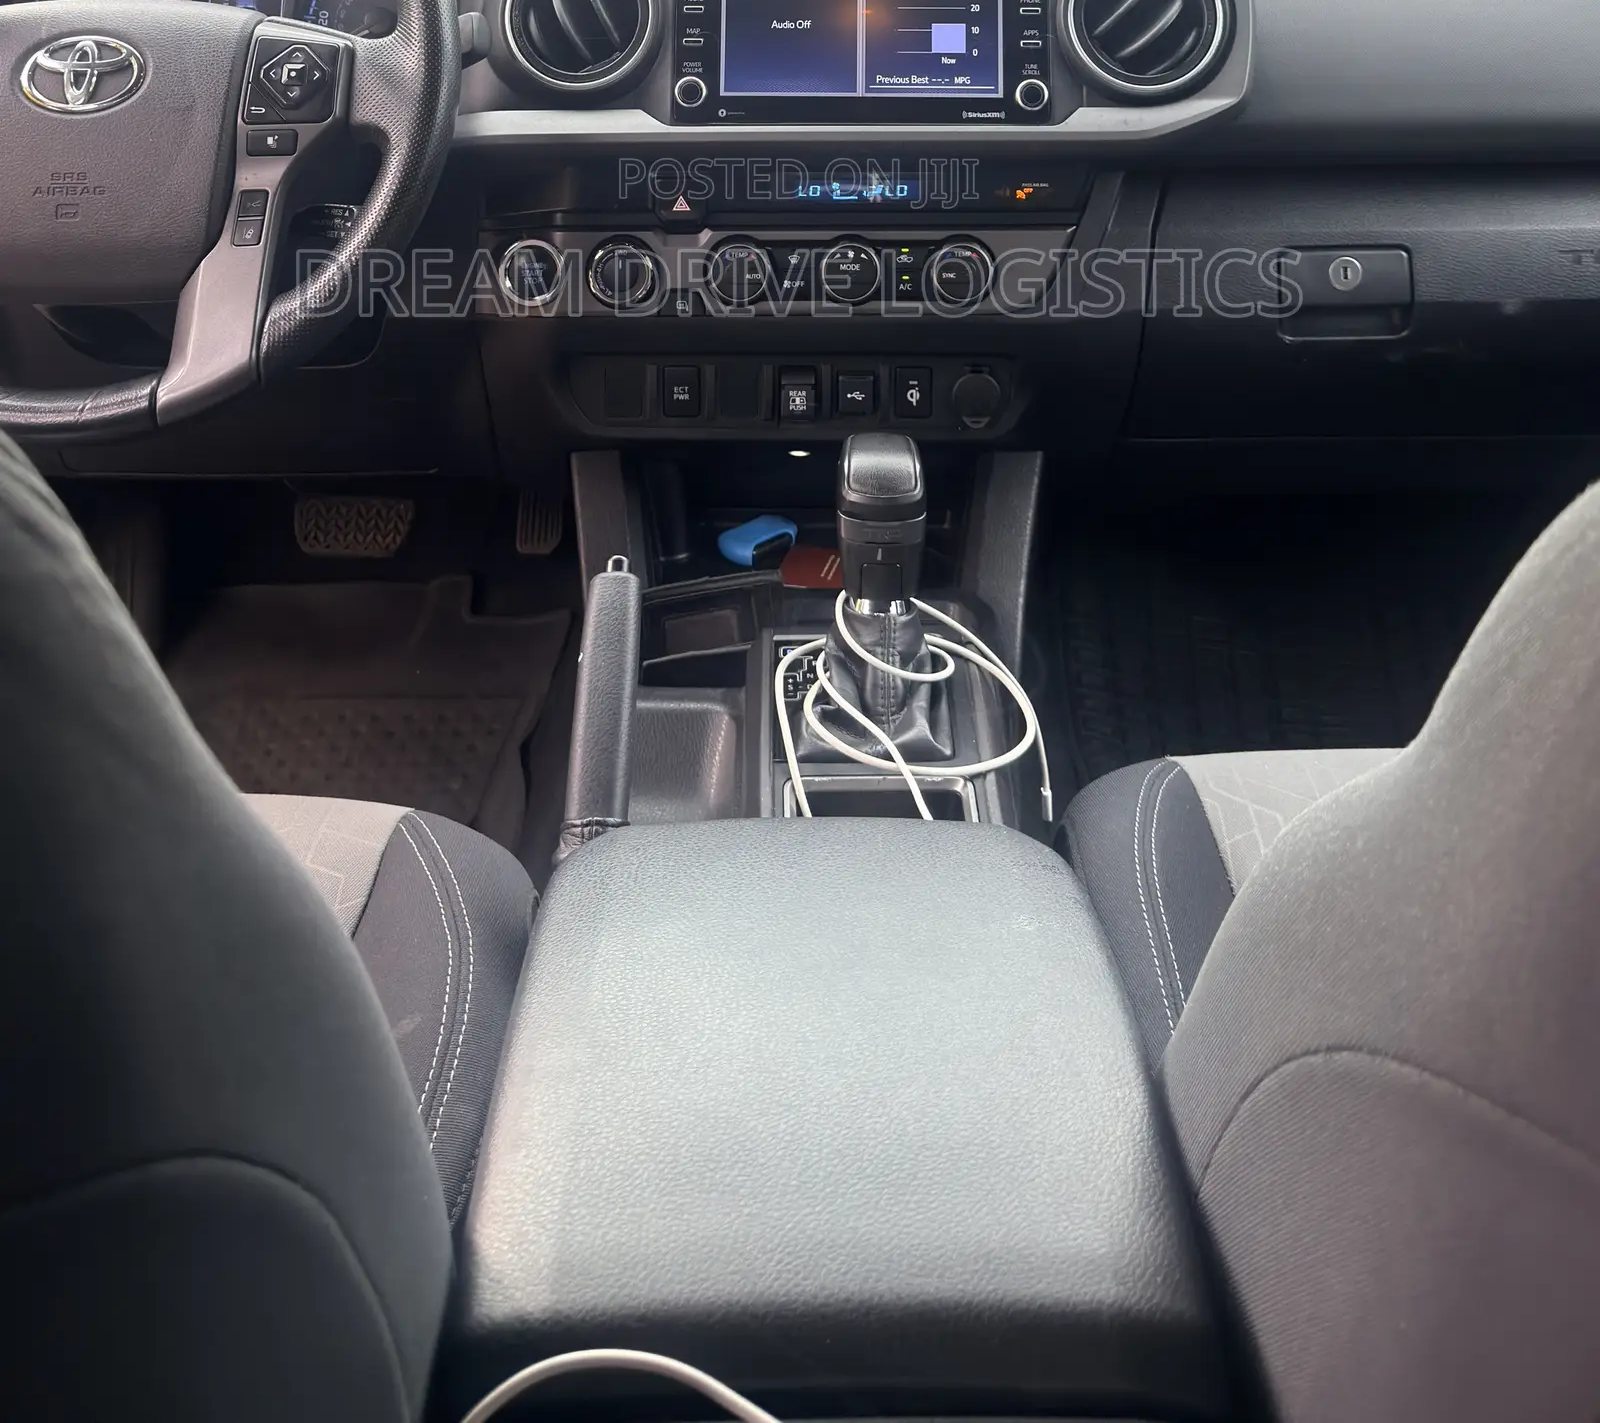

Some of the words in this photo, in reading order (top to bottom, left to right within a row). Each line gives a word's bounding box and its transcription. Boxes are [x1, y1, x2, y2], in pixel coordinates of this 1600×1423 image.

[970, 4, 980, 12] 20
[318, 10, 329, 26] 20
[771, 19, 795, 29] Audio
[796, 19, 811, 29] Off
[971, 26, 980, 34] 10
[876, 75, 910, 84] Previous
[911, 75, 929, 84] Best
[50, 171, 88, 182] SRS
[32, 186, 107, 197] AIRBAG
[840, 263, 861, 271] MODE
[524, 277, 543, 285] STOP
